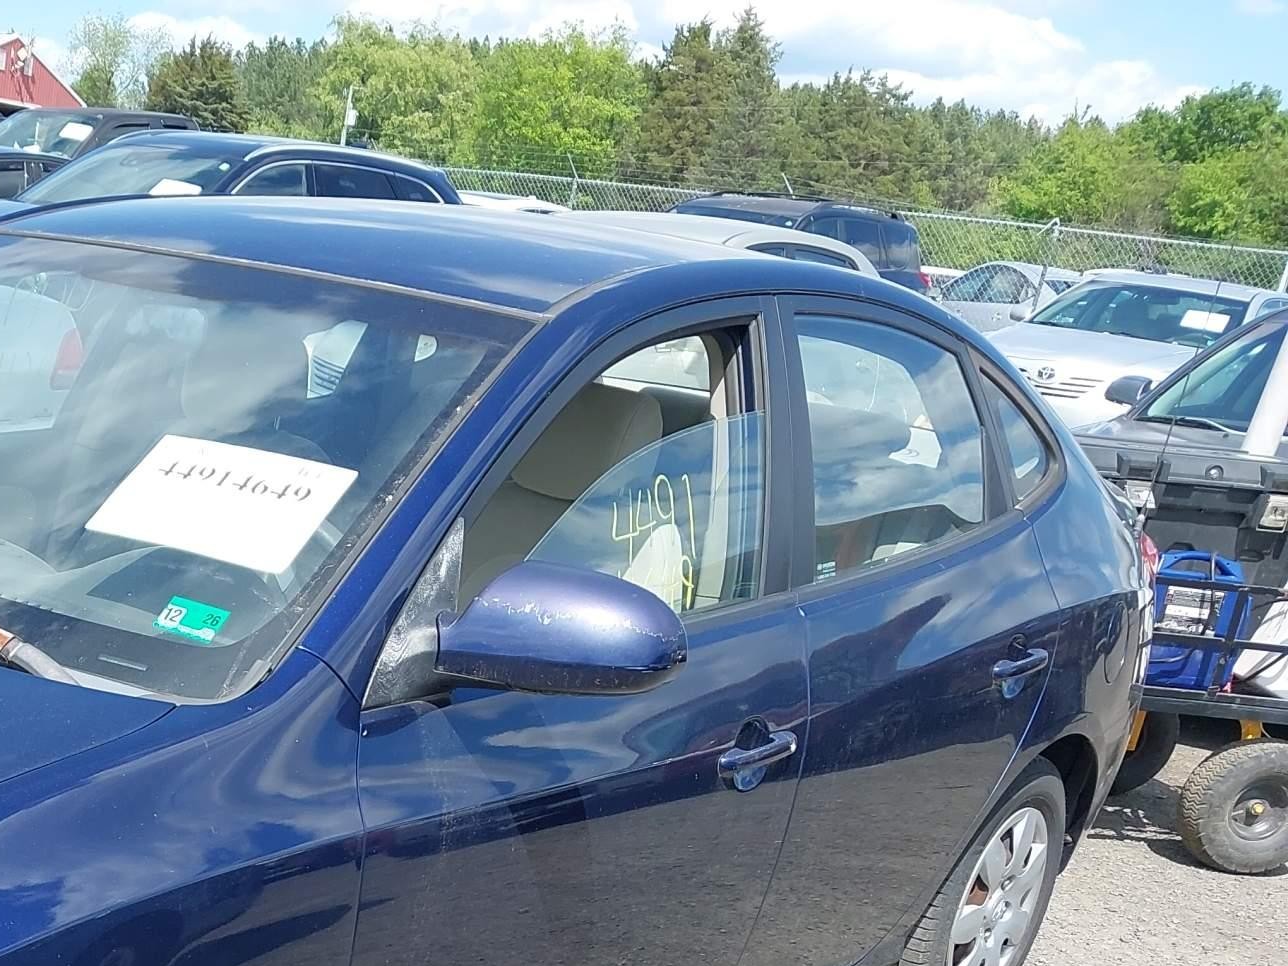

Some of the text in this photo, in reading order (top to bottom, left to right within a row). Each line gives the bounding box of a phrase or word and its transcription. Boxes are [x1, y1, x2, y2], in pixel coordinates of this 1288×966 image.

[611, 473, 697, 566] 4491
[163, 607, 222, 627] 12 26
